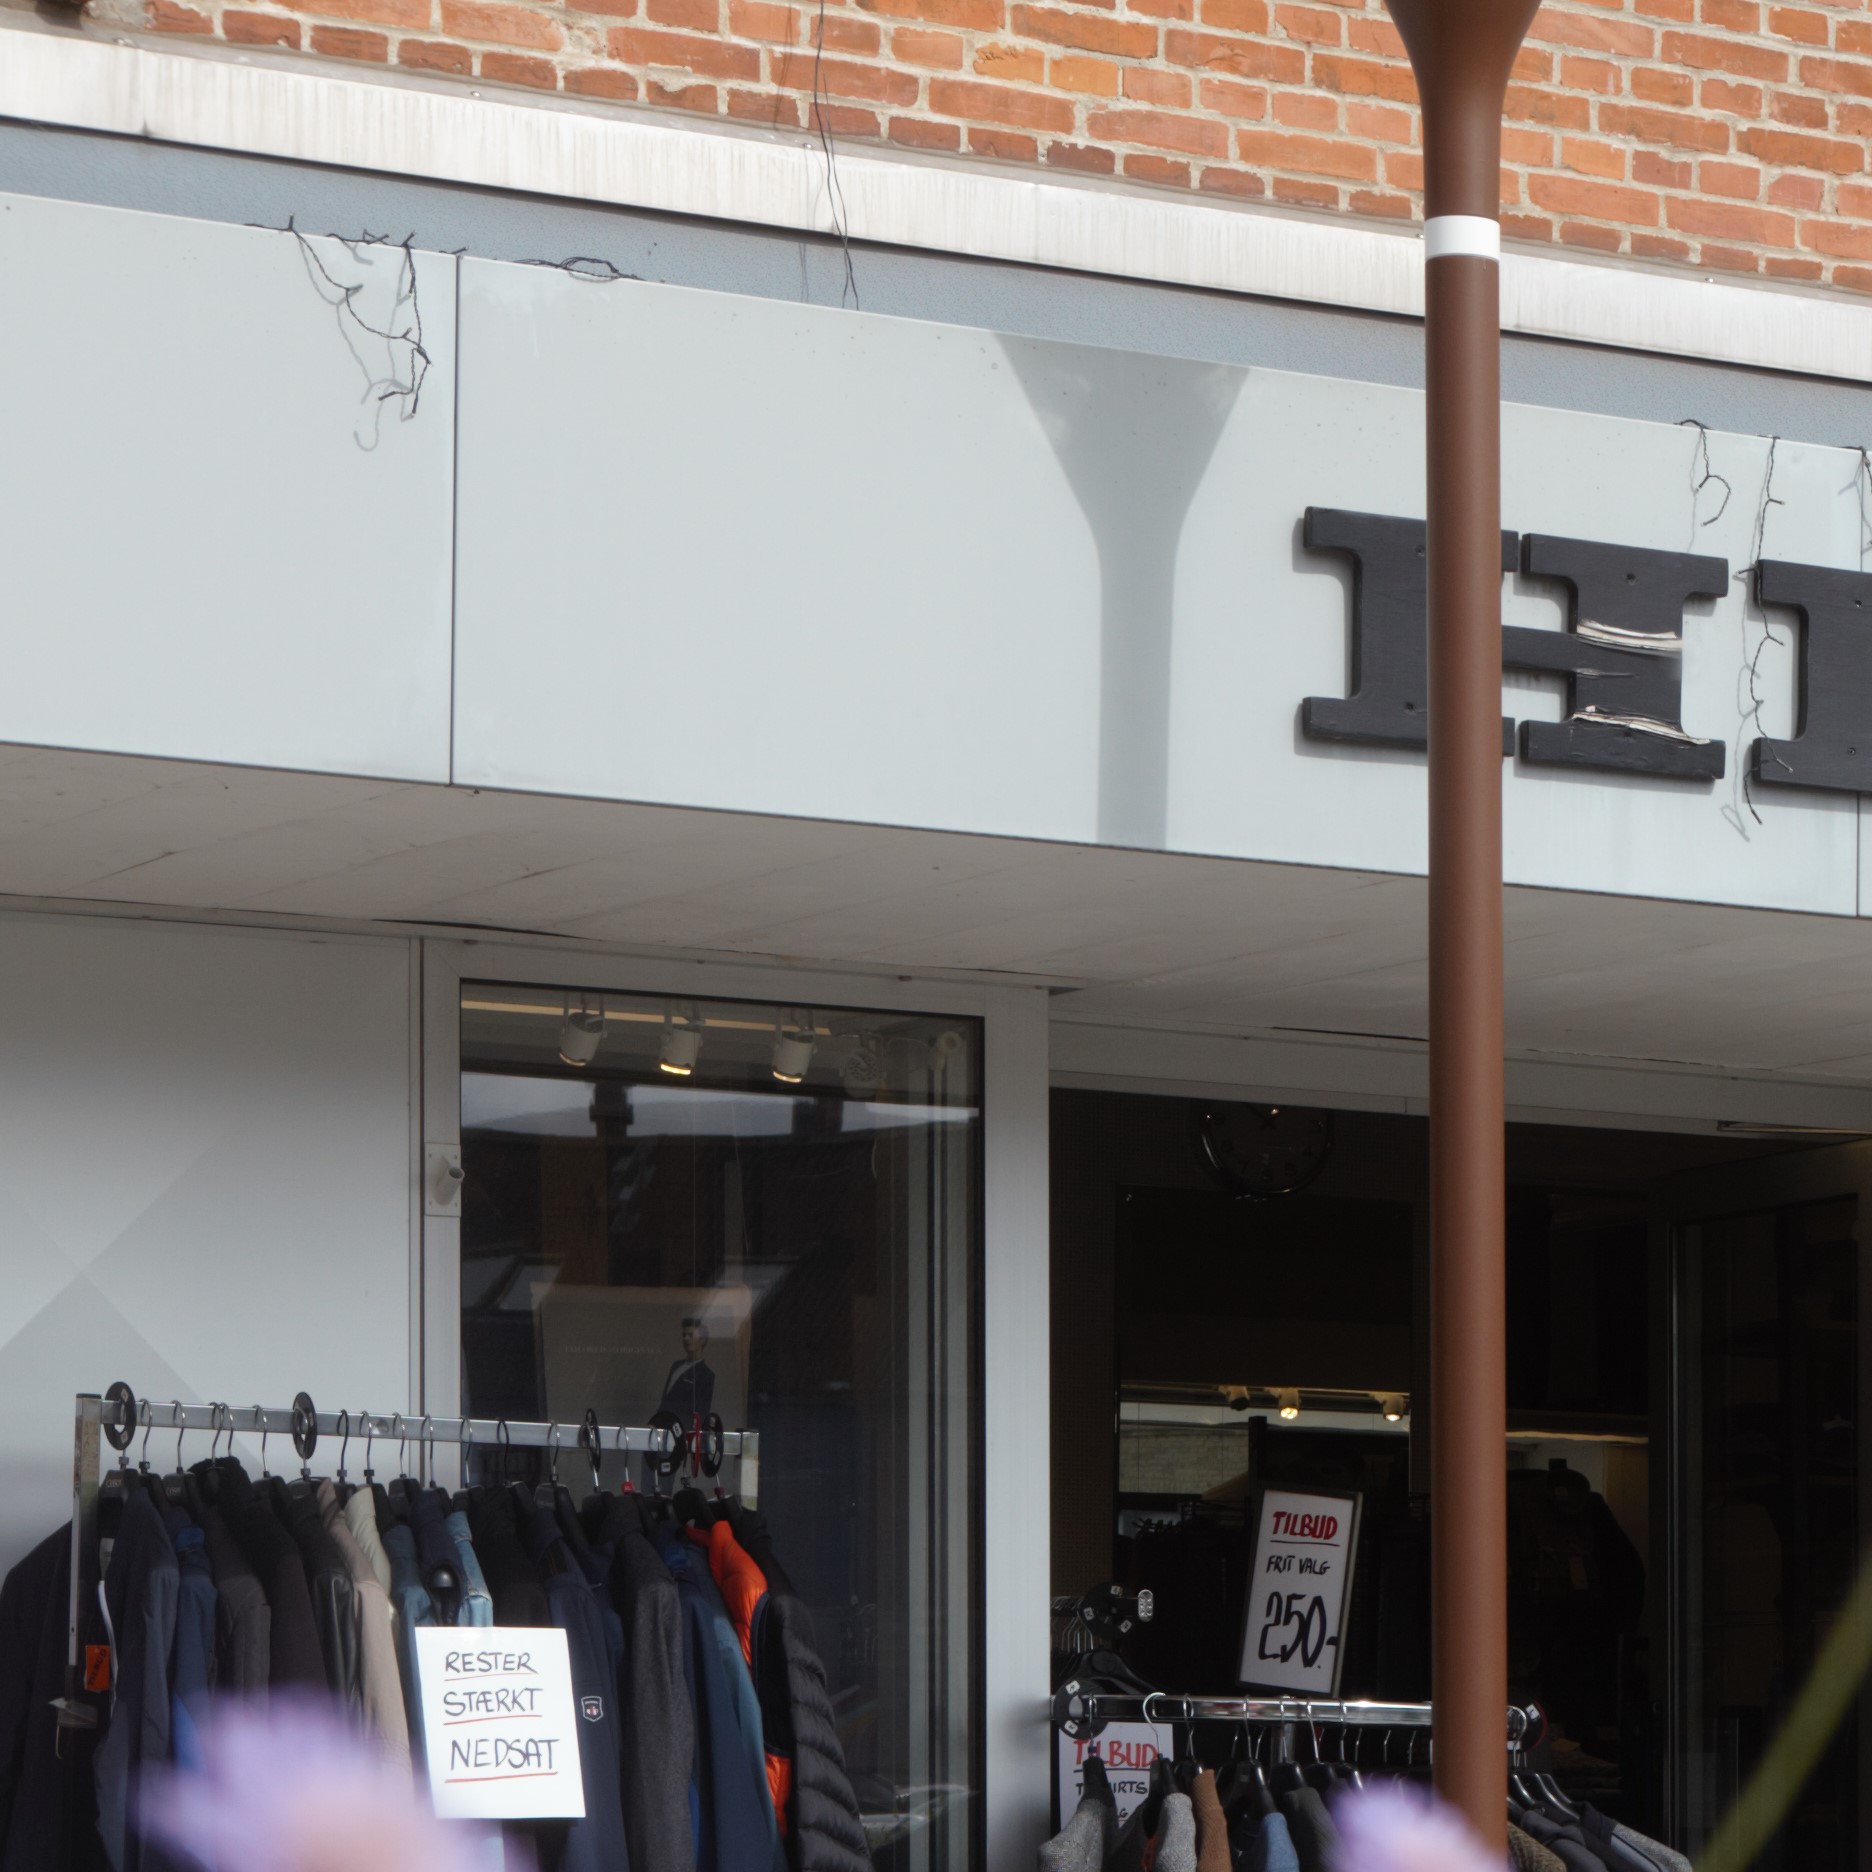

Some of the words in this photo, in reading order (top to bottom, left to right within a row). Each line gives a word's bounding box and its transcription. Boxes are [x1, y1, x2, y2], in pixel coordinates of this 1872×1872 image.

[1272, 1511, 1338, 1541] TILBUD
[1265, 1554, 1295, 1574] FRIT
[1298, 1557, 1331, 1576] VALG
[445, 1651, 539, 1674] RESTER
[443, 1688, 544, 1717] STÆRKT
[451, 1738, 560, 1770] NEDSAT
[1073, 1739, 1159, 1769] TLBUD
